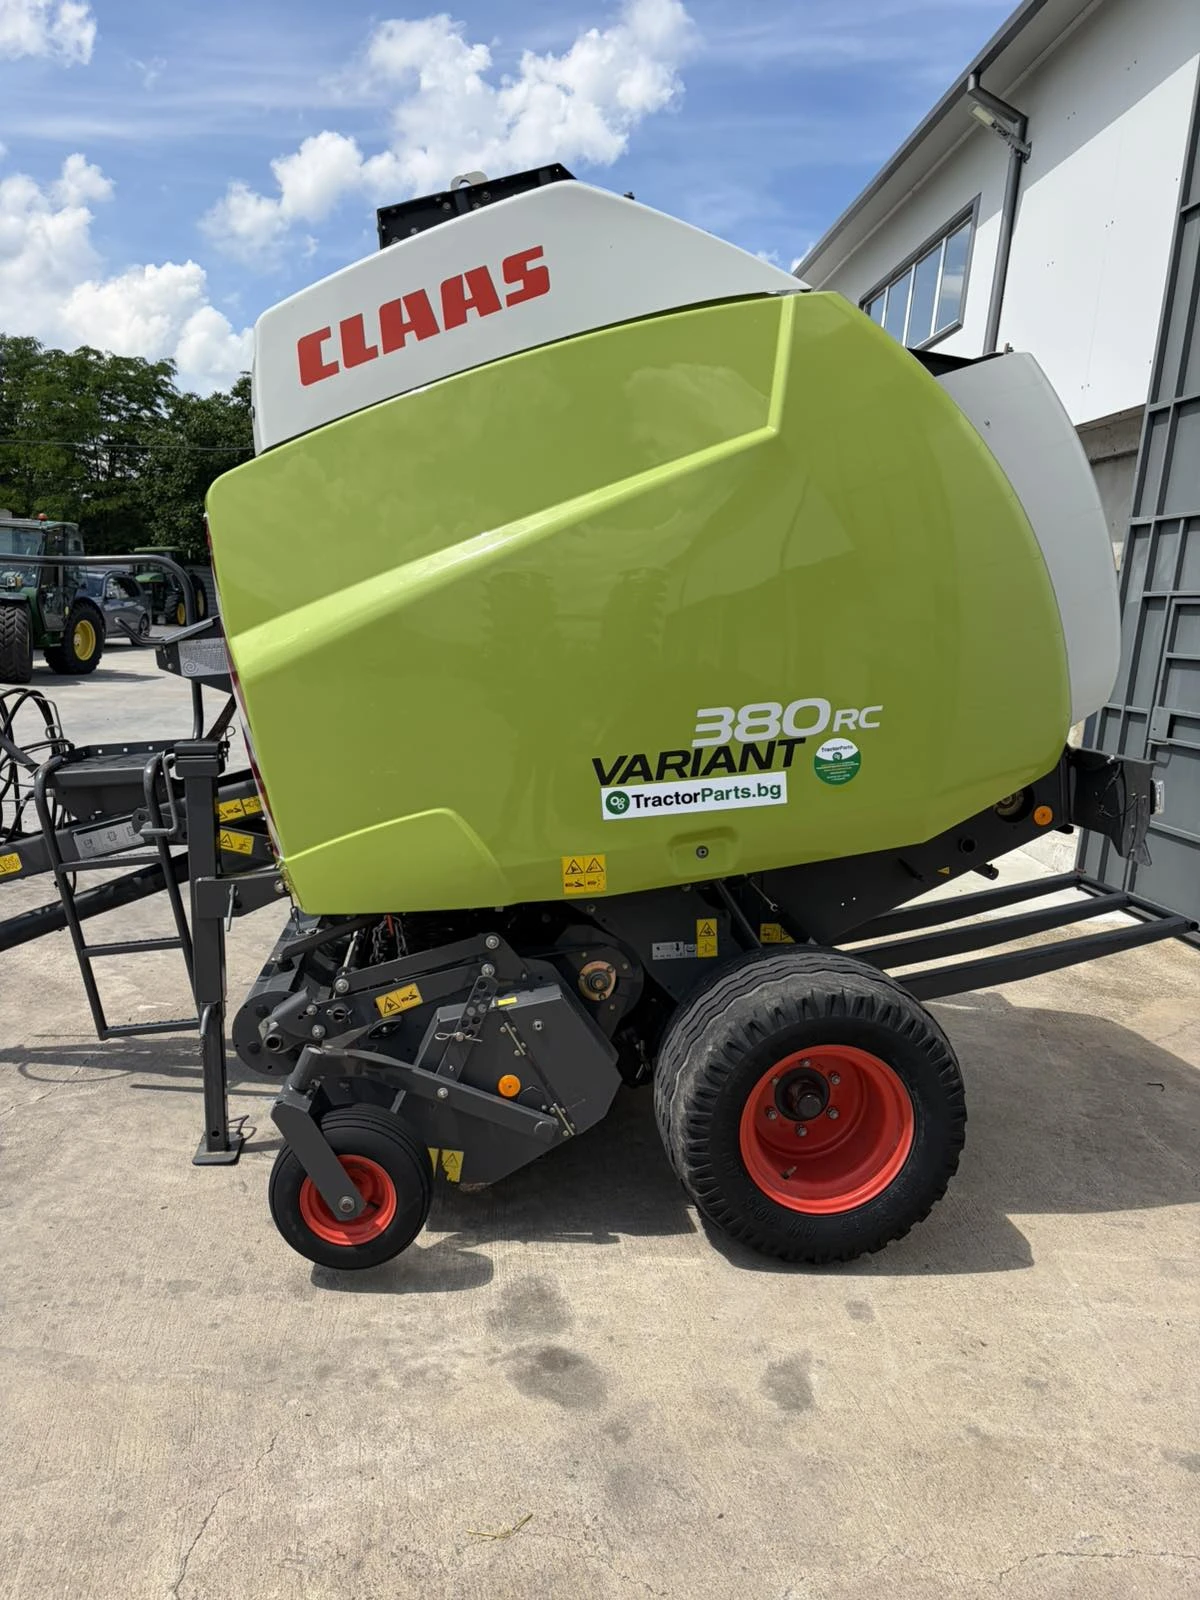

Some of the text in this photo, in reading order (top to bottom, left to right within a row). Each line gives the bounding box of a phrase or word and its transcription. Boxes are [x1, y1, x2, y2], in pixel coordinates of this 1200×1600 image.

[297, 245, 551, 386] CLAAS
[691, 697, 884, 748] 380 RC
[591, 737, 806, 786] VARIANT
[631, 782, 782, 809] TractorParts.bg
